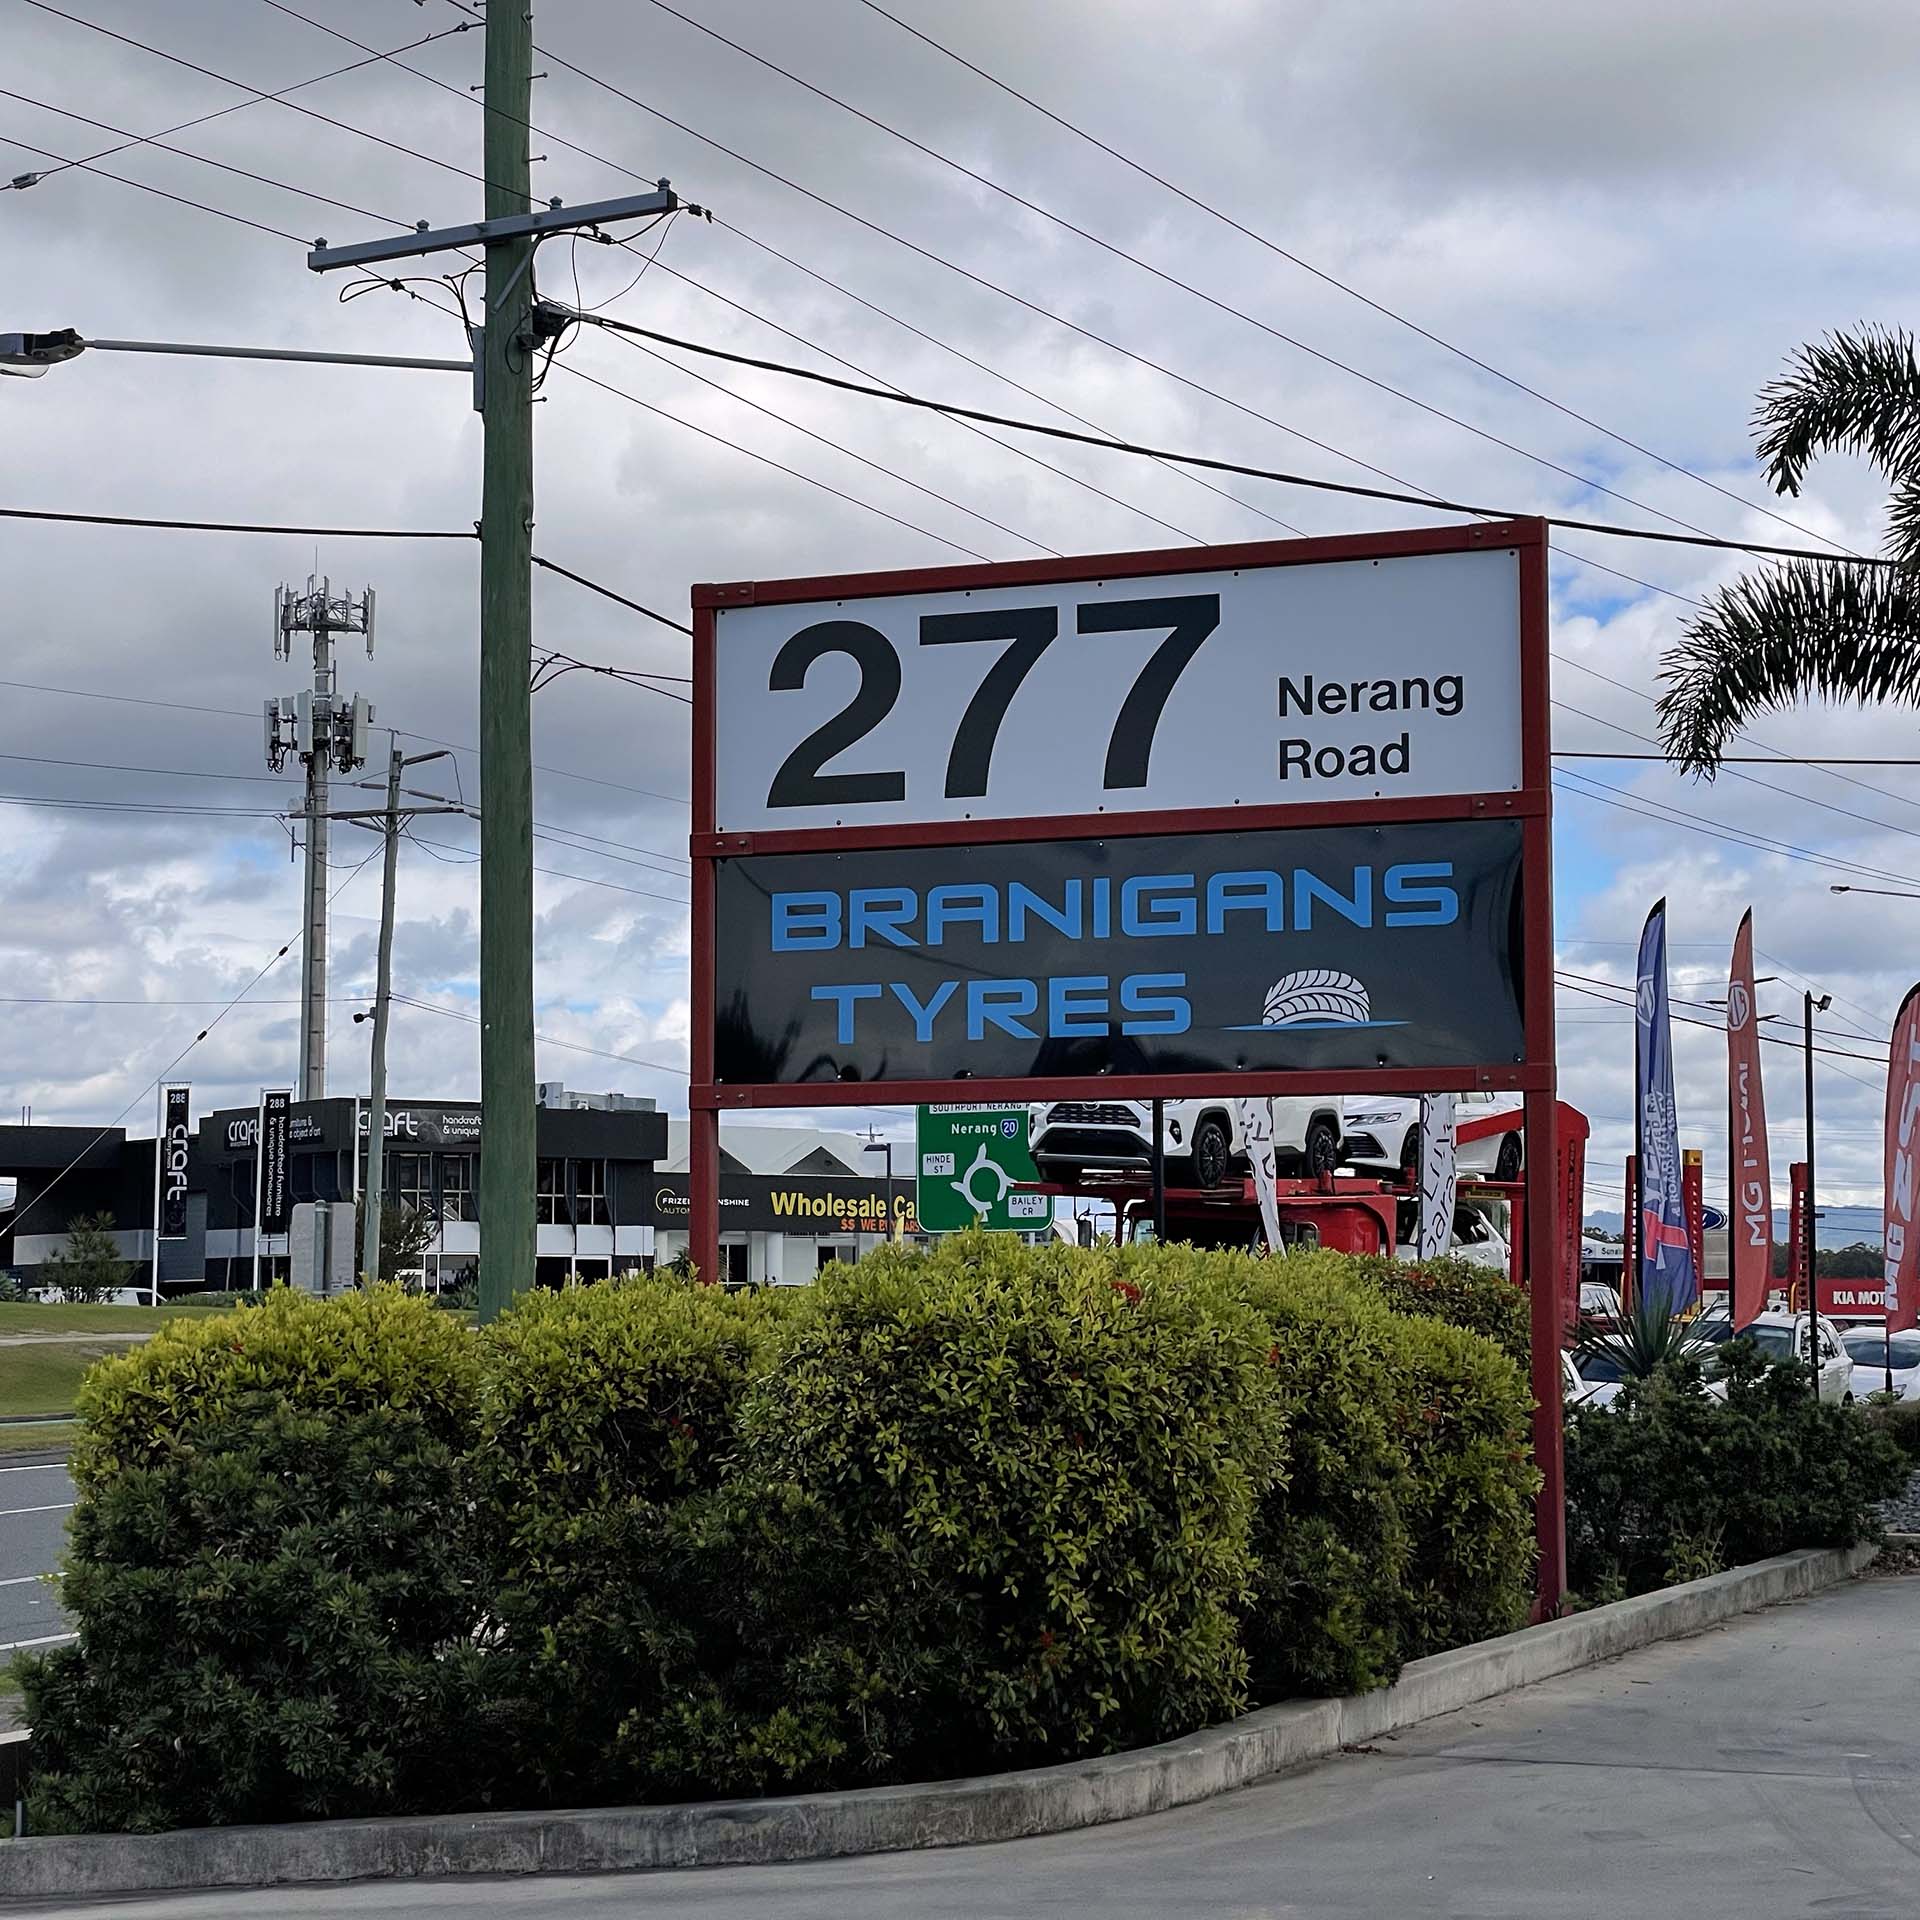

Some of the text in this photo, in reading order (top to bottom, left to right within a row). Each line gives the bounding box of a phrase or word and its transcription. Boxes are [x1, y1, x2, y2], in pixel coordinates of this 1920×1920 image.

[766, 592, 1221, 809] 277
[1278, 673, 1465, 718] Nerang
[1278, 732, 1411, 781] Road
[771, 862, 1460, 953] BRANIGANS
[810, 972, 1192, 1045] TYRES
[269, 1098, 285, 1109] 288
[443, 1115, 481, 1125] handcraft
[443, 1126, 480, 1137] & unique
[952, 1121, 1015, 1136] Nerang 20
[278, 1116, 286, 1174] handcrafted
[167, 1124, 189, 1200] craft
[926, 1155, 951, 1163] HINDE
[934, 1166, 944, 1174] ST
[662, 1197, 750, 1207] FRIZE NSHINE
[771, 1191, 915, 1219] Wholesale Ca
[1011, 1197, 1044, 1205] BAILEY
[1022, 1207, 1033, 1215] CR
[1742, 1181, 1767, 1246] MG
[861, 1218, 876, 1231] WE
[905, 1220, 920, 1232] ARS
[1885, 1222, 1904, 1311] MG
[1833, 1291, 1885, 1305] KIA MOT
